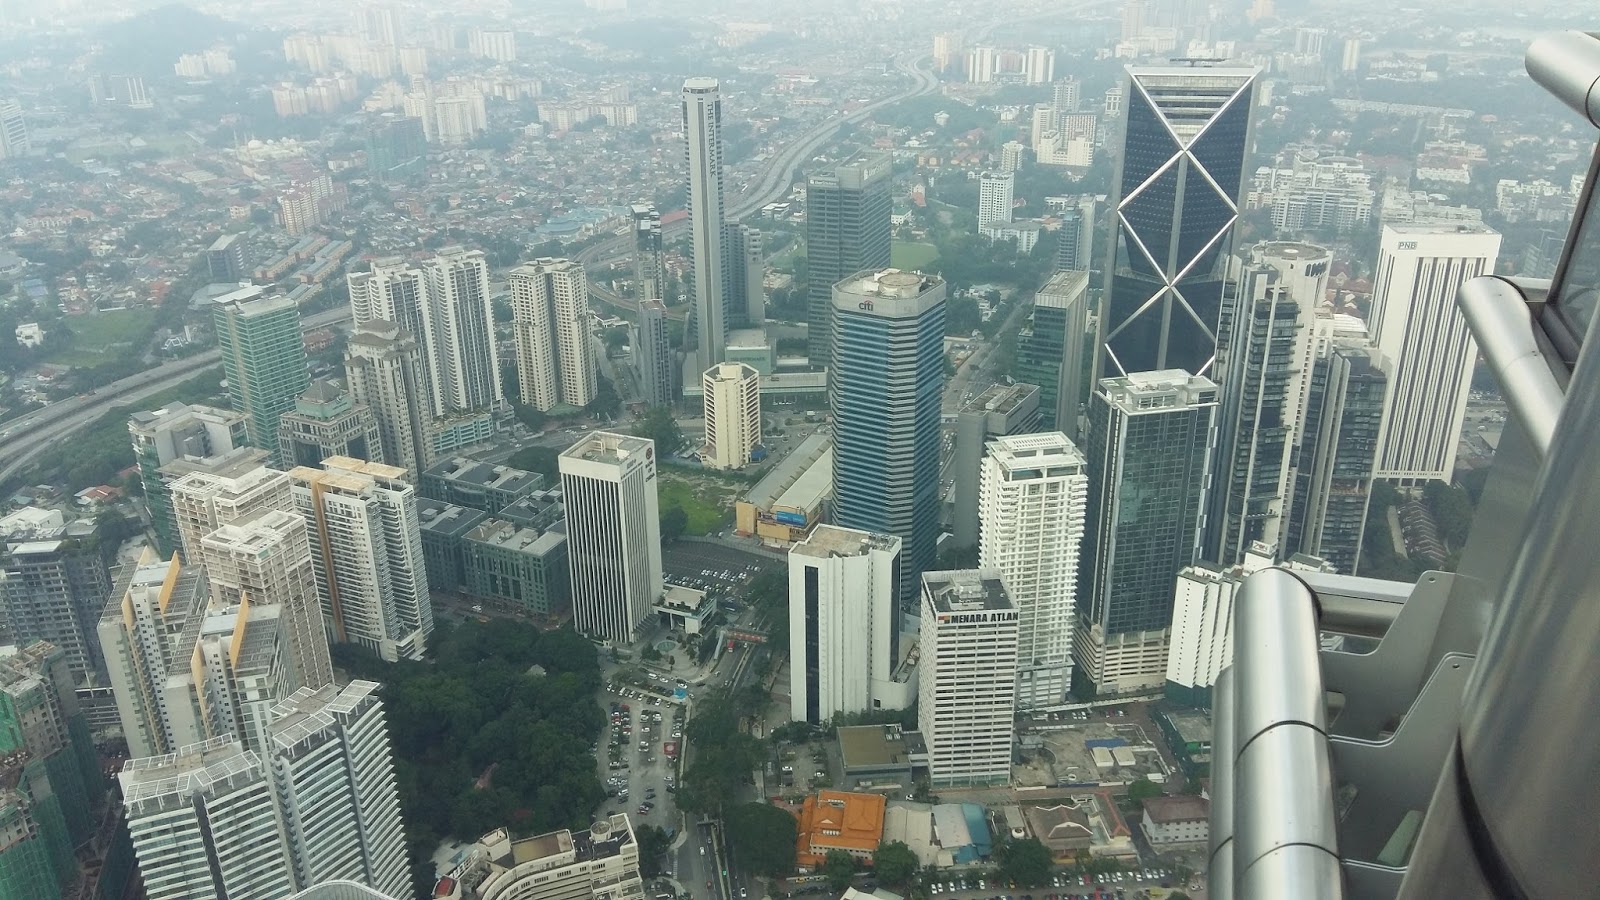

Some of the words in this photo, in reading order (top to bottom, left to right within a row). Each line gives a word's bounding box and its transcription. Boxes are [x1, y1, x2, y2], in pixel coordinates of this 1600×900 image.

[708, 122, 716, 178] INTERMARK
[1398, 241, 1417, 250] PNB
[859, 300, 874, 311] citi
[951, 613, 988, 624] MENARA
[990, 612, 1019, 622] ATLAN
